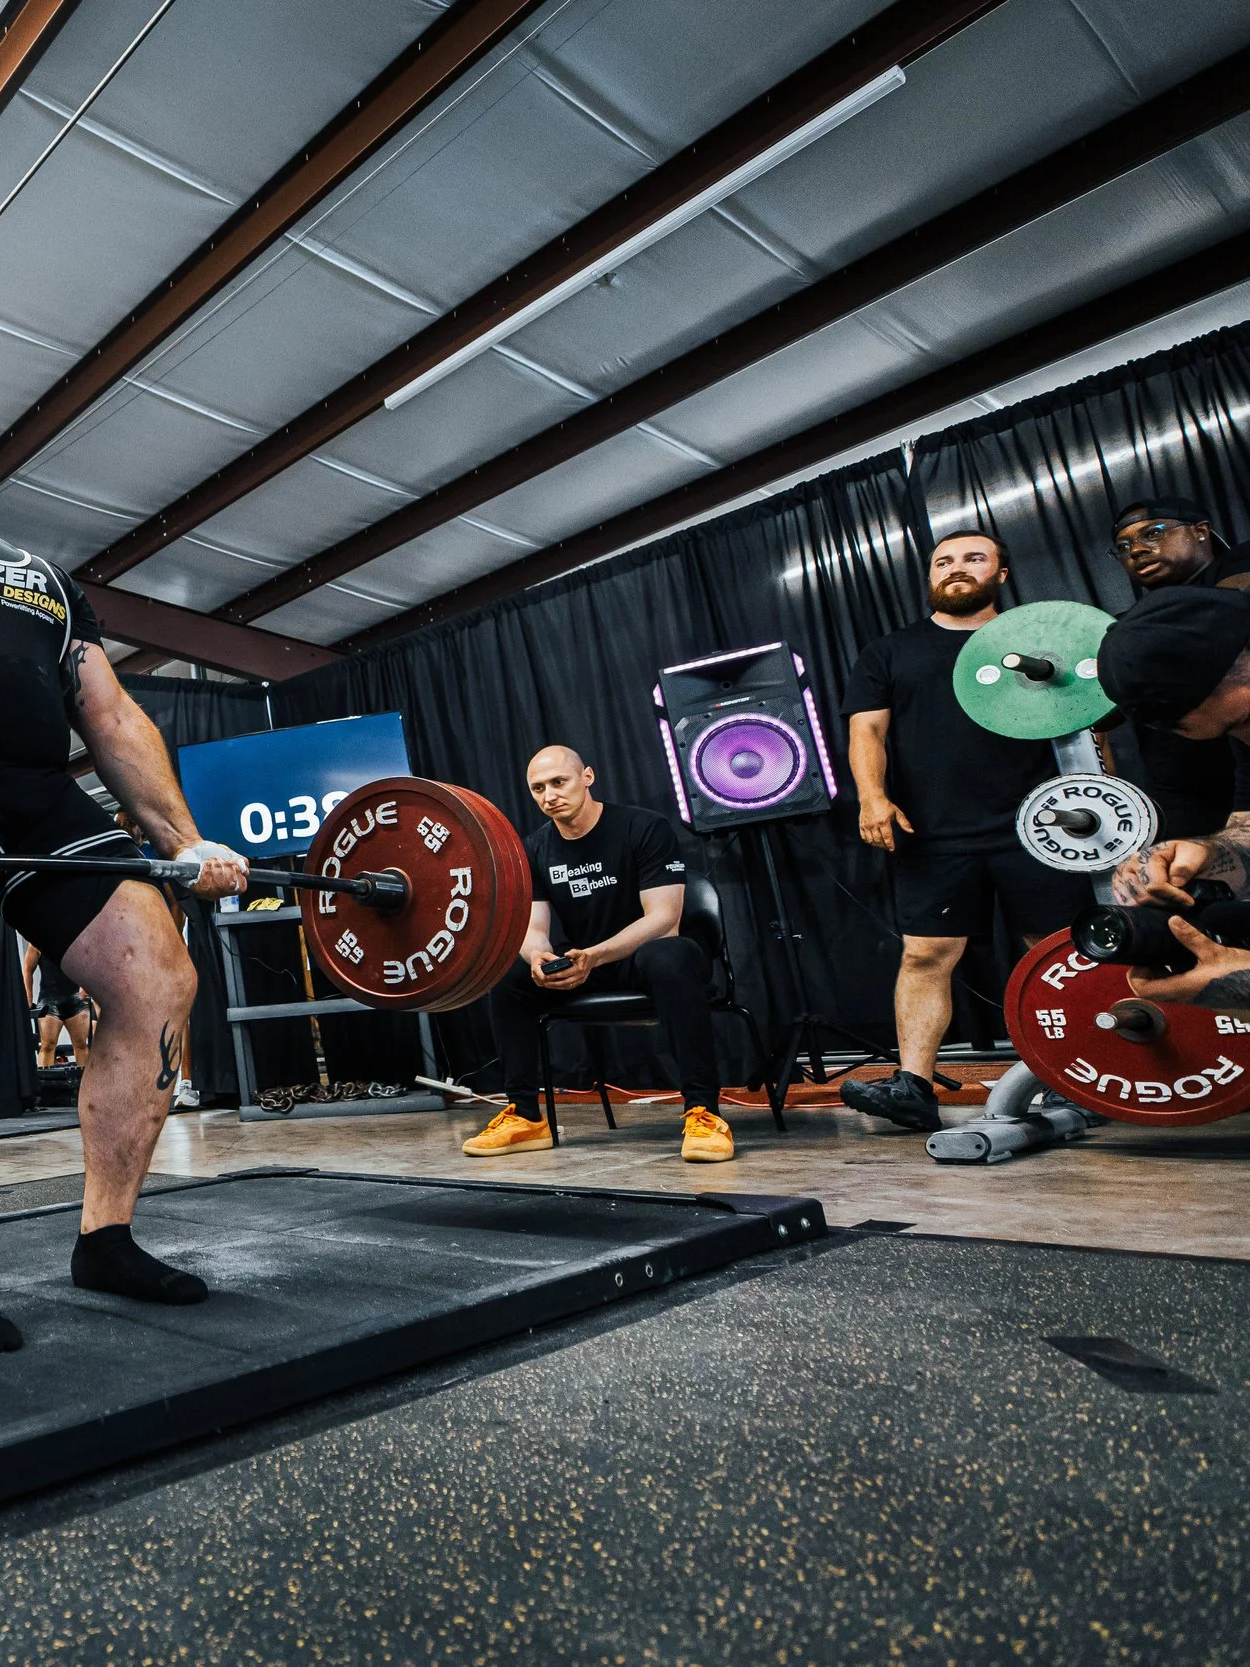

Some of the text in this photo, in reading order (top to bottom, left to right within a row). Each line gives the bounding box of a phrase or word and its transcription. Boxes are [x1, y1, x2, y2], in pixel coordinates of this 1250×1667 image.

[0, 598, 35, 616] Powerlifting
[35, 609, 55, 625] Apparel
[3, 586, 66, 620] DESIGNS
[1062, 786, 1133, 832] ROGUE
[416, 815, 434, 838] LB
[423, 822, 451, 854] 55
[318, 801, 399, 915] ROGUE
[551, 862, 603, 881] Breaking
[571, 875, 618, 894] Barbells
[383, 866, 473, 986] ROGUE
[334, 928, 359, 959] 55
[348, 946, 366, 965] LB
[1035, 1008, 1068, 1027] 55
[1044, 1026, 1065, 1040] LB
[1063, 1054, 1245, 1104] ROGUE
